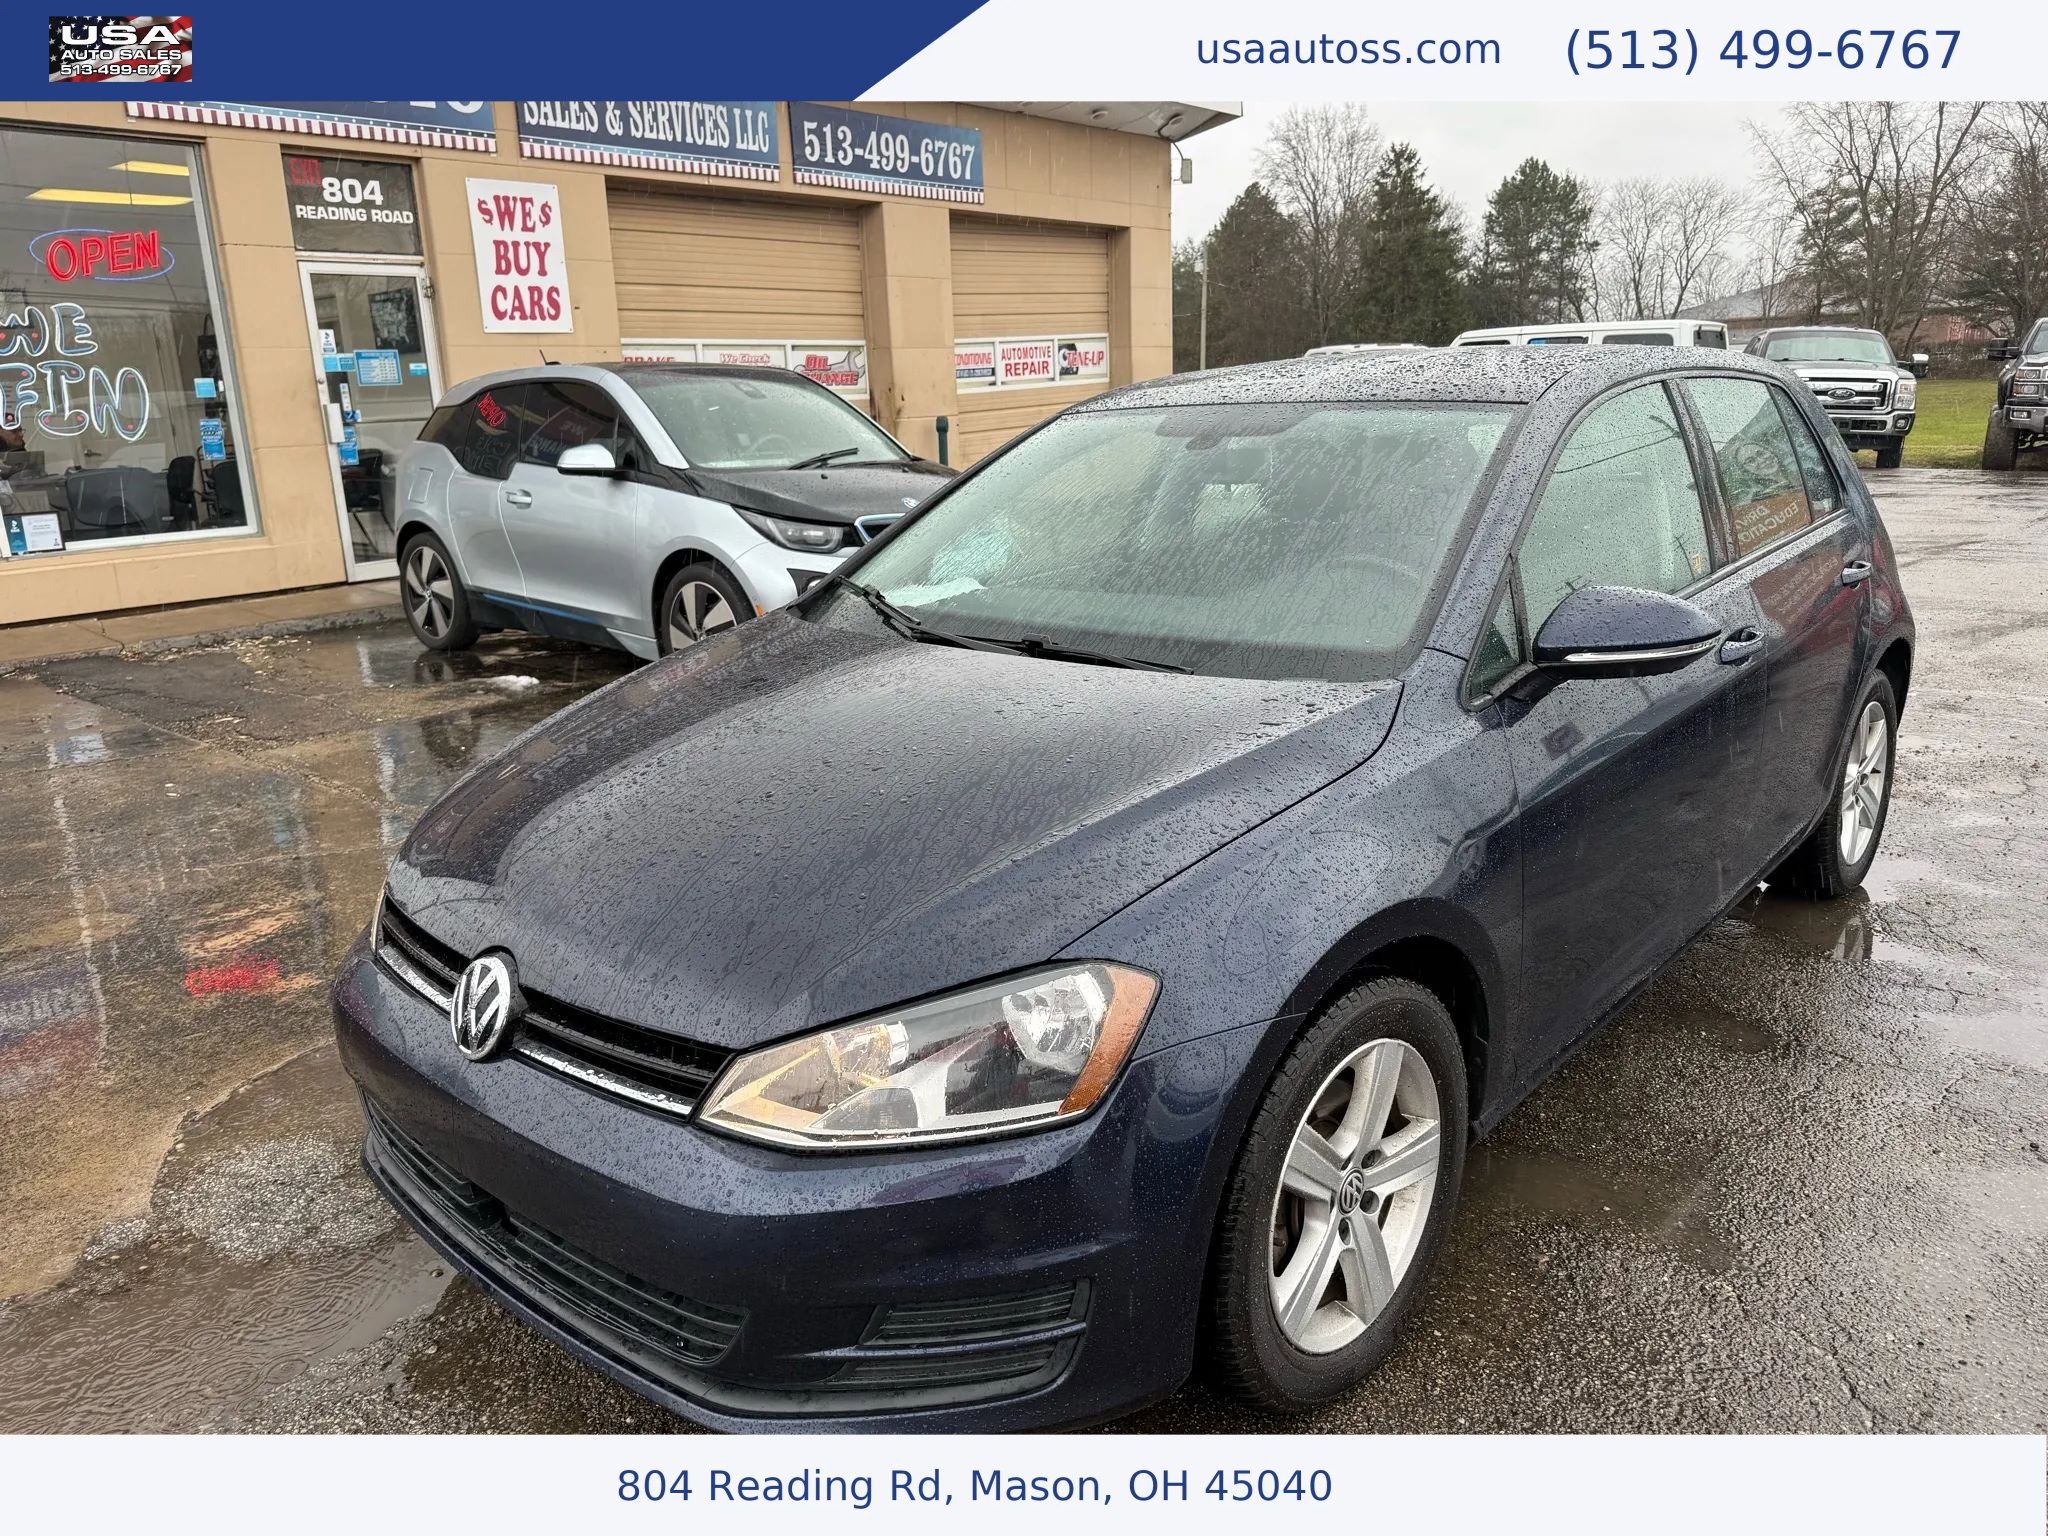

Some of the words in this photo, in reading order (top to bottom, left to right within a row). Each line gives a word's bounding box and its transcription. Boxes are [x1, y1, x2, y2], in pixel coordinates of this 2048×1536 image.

[524, 101, 599, 133] SALES
[605, 101, 624, 137] &
[630, 101, 730, 149] SERVICES
[734, 108, 769, 153] LLC
[803, 120, 976, 181] 513-499-6767
[321, 176, 384, 206] 804
[295, 204, 368, 222] READING
[370, 208, 414, 224] ROAD
[46, 229, 161, 282] OPEN
[492, 239, 552, 278] BUY
[490, 284, 562, 322] CARS
[805, 354, 831, 371] OIL
[1001, 345, 1052, 361] AUTOMOTIVE
[1066, 350, 1104, 368] TUNE-UP
[1004, 360, 1050, 377] REPAIR
